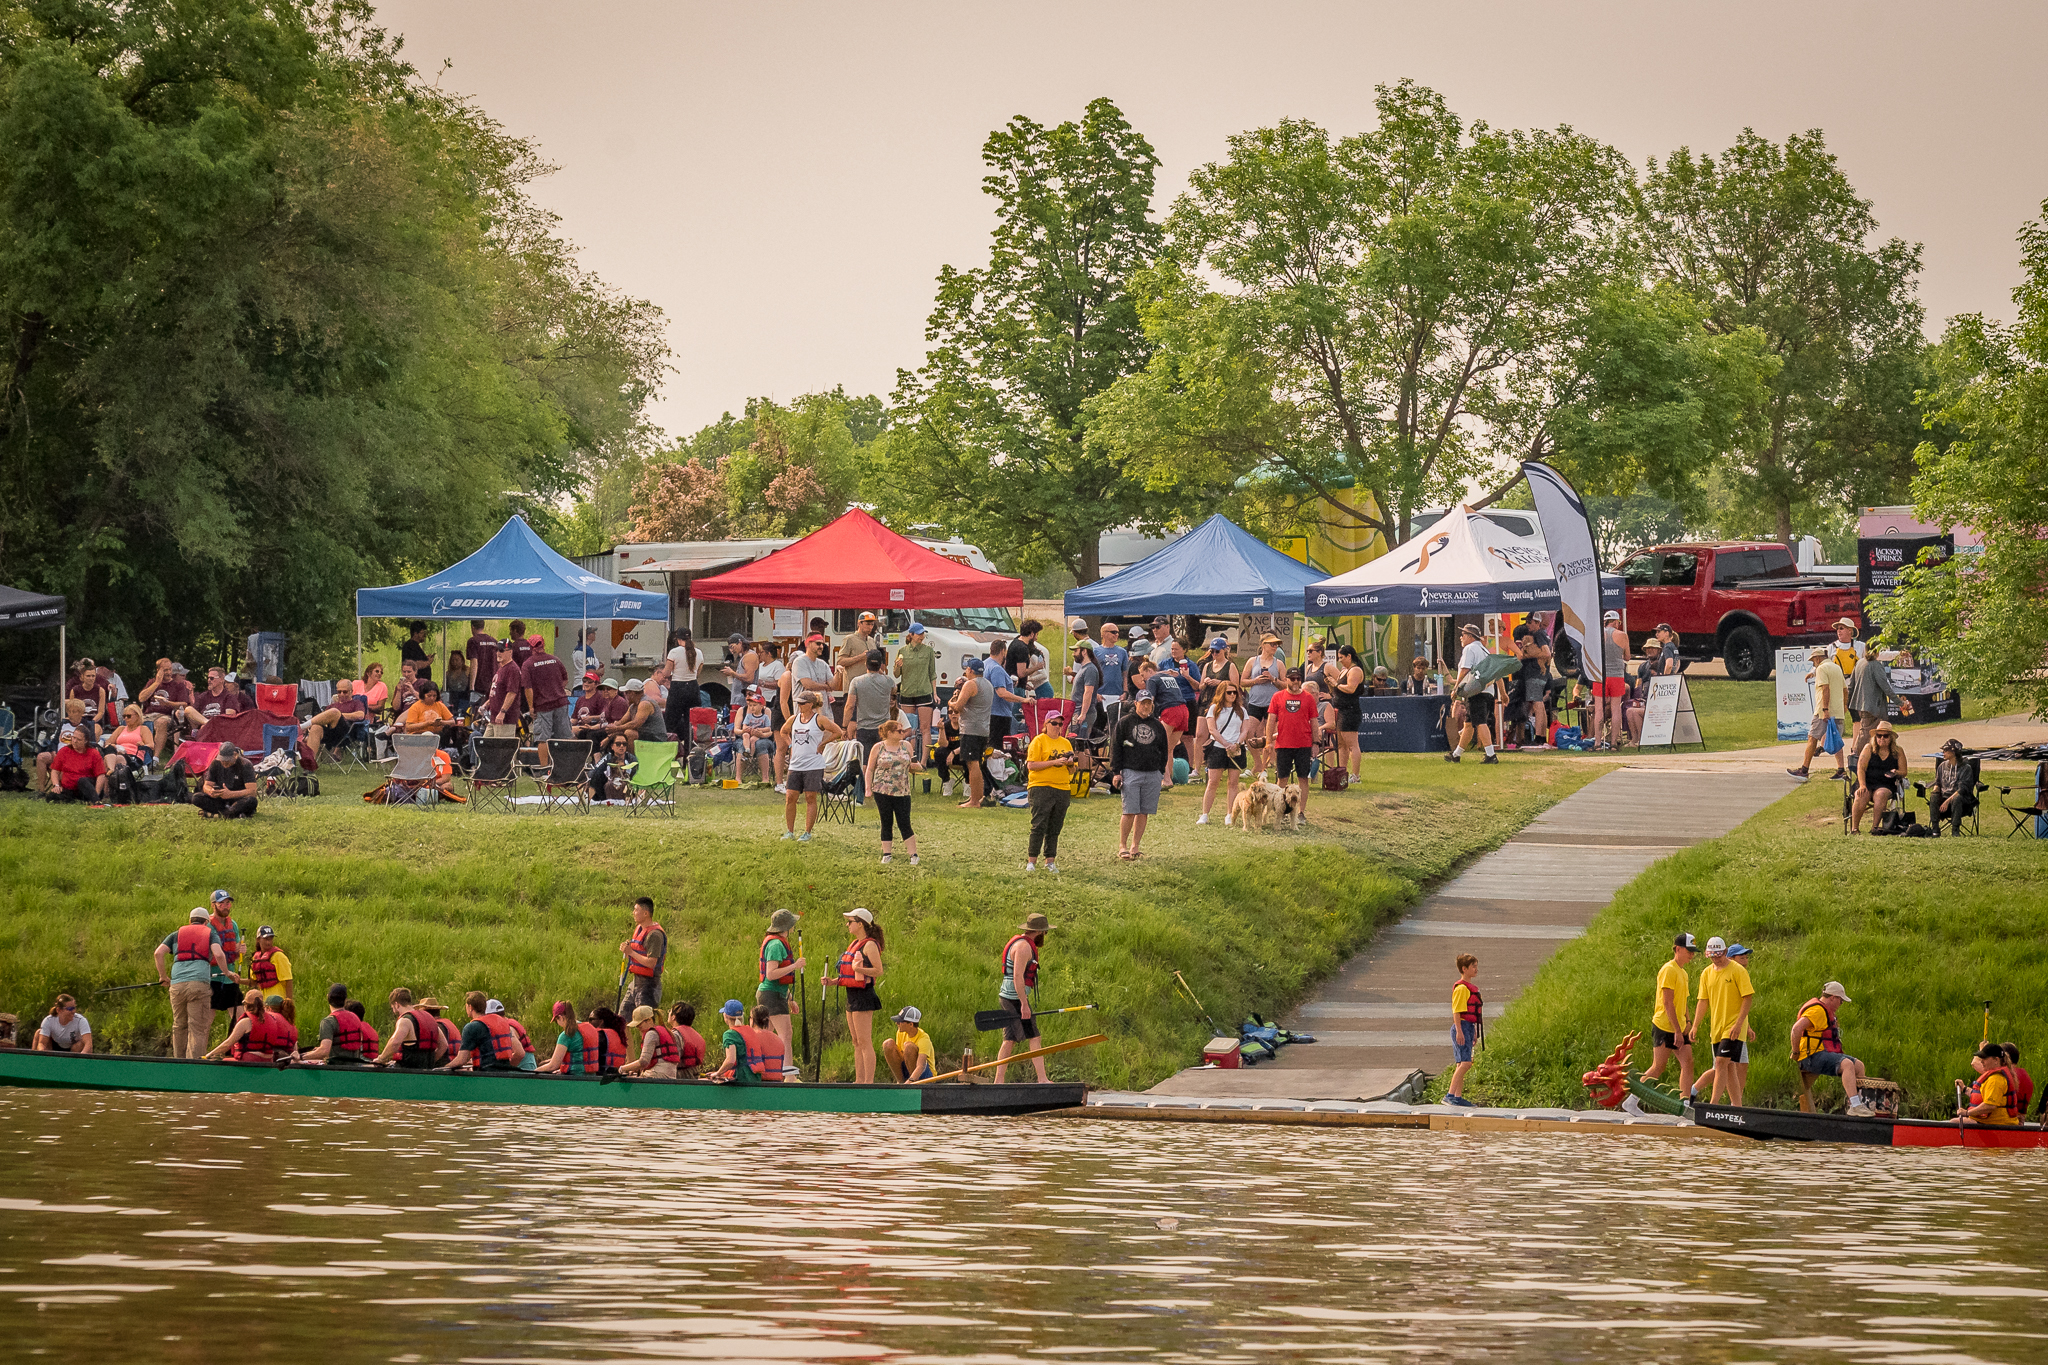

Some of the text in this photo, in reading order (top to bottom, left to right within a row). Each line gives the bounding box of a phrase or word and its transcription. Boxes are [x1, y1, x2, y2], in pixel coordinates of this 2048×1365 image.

[456, 577, 542, 587] BOEING
[1872, 578, 1903, 586] WATER?
[1329, 594, 1379, 605] www.nacf.ca
[1502, 589, 1534, 602] Supporting
[449, 598, 510, 608] BOEING
[619, 600, 642, 610] BOEING
[623, 632, 639, 640] ood
[1782, 652, 1805, 663] Feel
